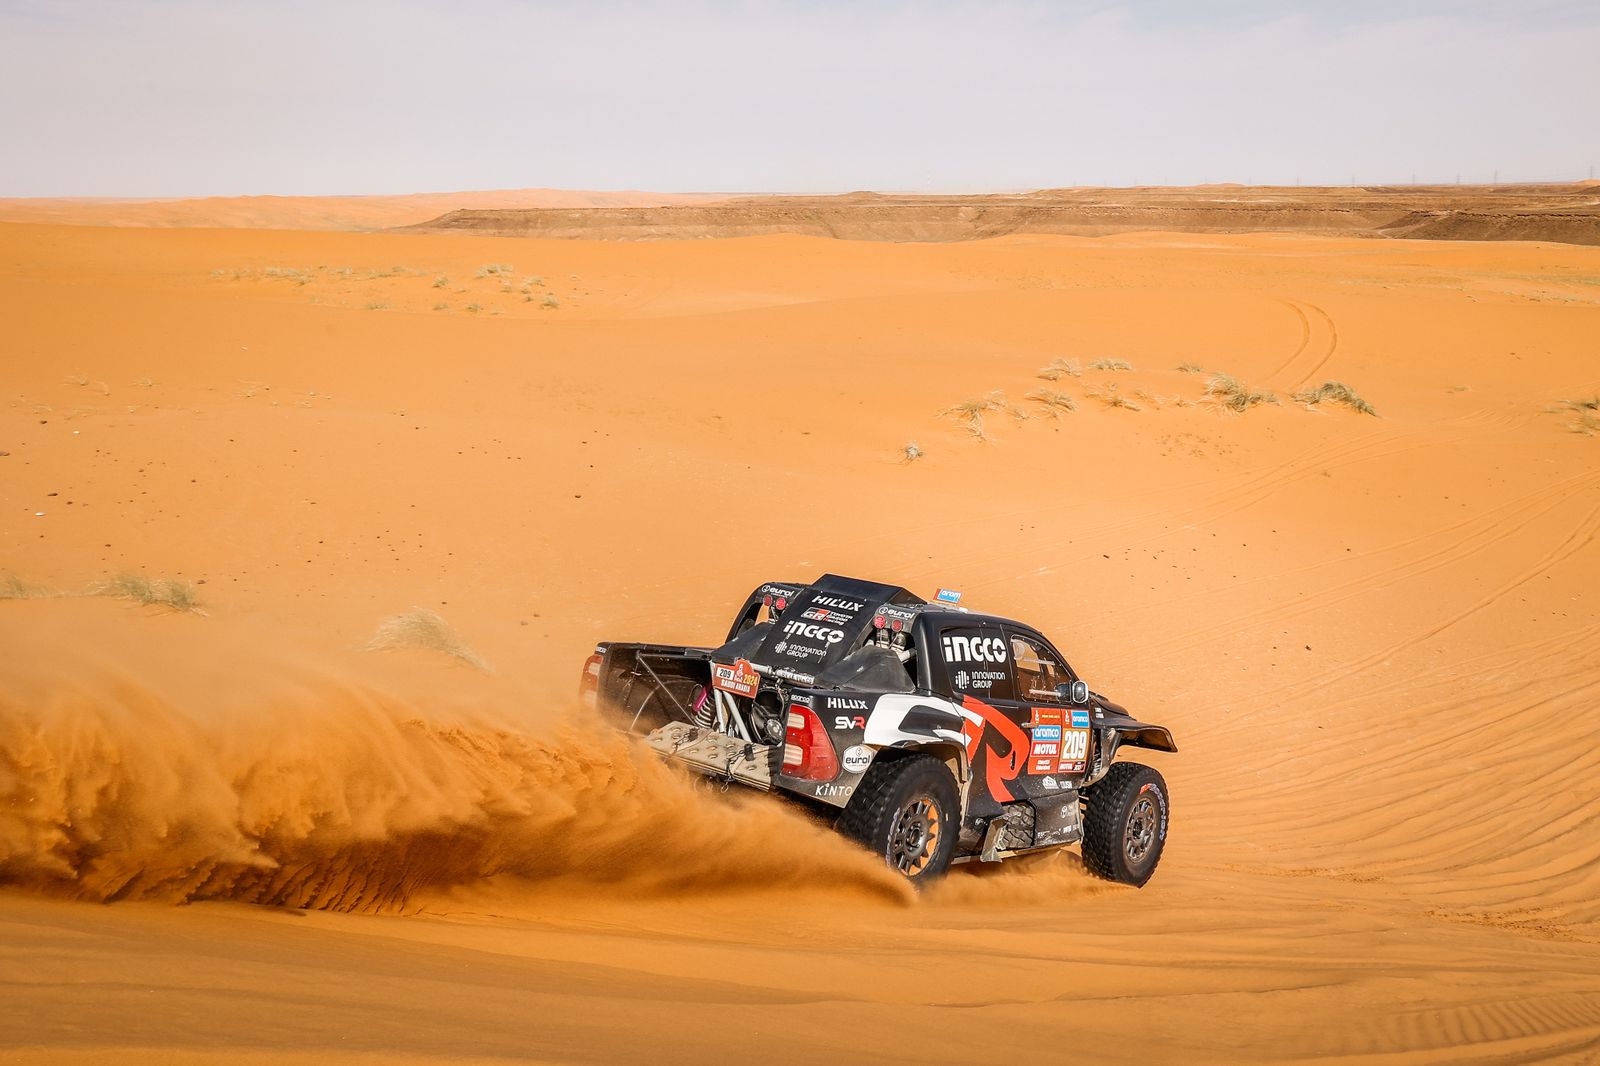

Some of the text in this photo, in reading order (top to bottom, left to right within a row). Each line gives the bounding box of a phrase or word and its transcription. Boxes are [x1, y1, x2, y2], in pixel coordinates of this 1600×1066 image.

[769, 587, 795, 597] eurol
[811, 595, 865, 612] HILUX
[888, 608, 915, 619] eurol
[786, 649, 809, 658] GROUP
[719, 669, 732, 678] 209
[743, 674, 758, 686] 2024
[972, 680, 993, 688] GROUP
[827, 697, 869, 710] HILUX
[834, 716, 865, 730] SVR
[1034, 727, 1059, 738] aramco
[1033, 744, 1057, 755] MOTUL
[1062, 730, 1087, 759] 209
[845, 755, 871, 764] eurol
